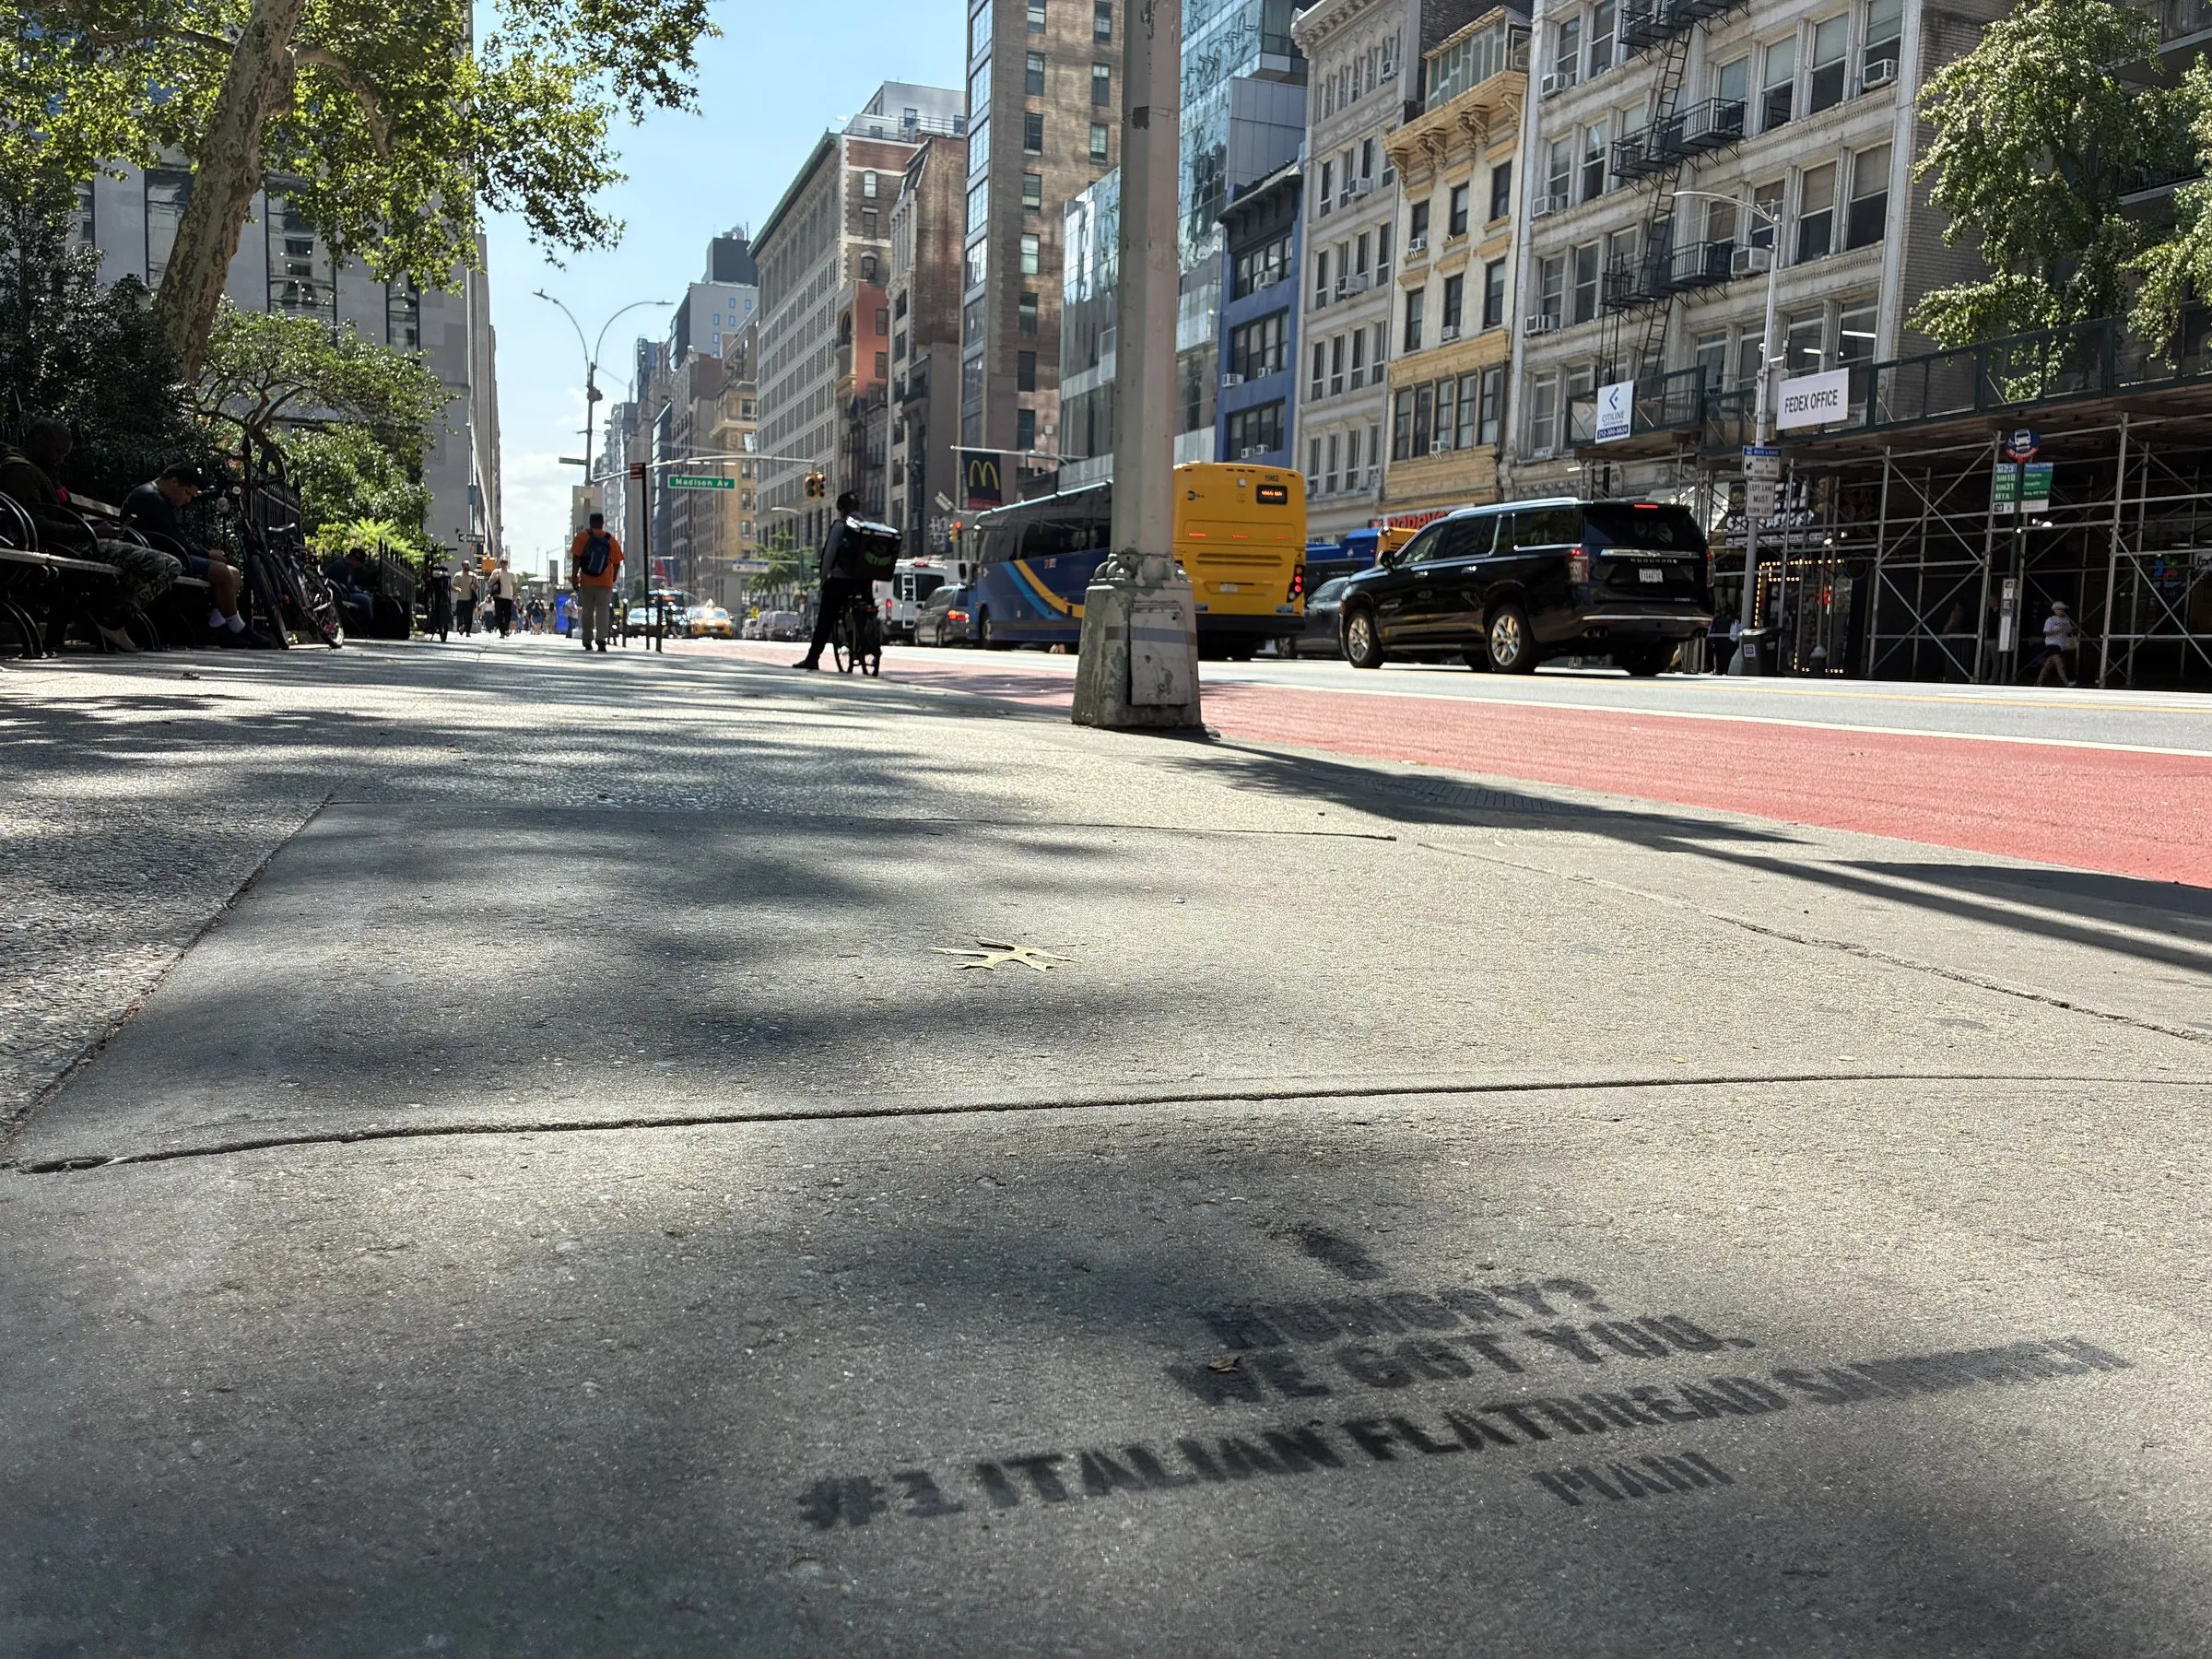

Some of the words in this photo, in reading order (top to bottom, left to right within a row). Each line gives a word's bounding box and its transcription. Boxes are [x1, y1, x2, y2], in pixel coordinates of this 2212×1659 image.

[1784, 394, 1809, 413] FEDEX
[1810, 389, 1839, 409] OFFICE
[676, 478, 712, 487] Madison
[717, 479, 729, 488] Av
[1753, 495, 1768, 503] MUST
[1200, 1277, 1611, 1351] HUNGRY?
[1335, 1333, 1526, 1387] GOT
[1525, 1312, 1755, 1365] YOU.
[796, 1469, 964, 1530] #1
[975, 1425, 1346, 1509] ITALIAN
[1337, 1377, 1789, 1461] FLATBREAD
